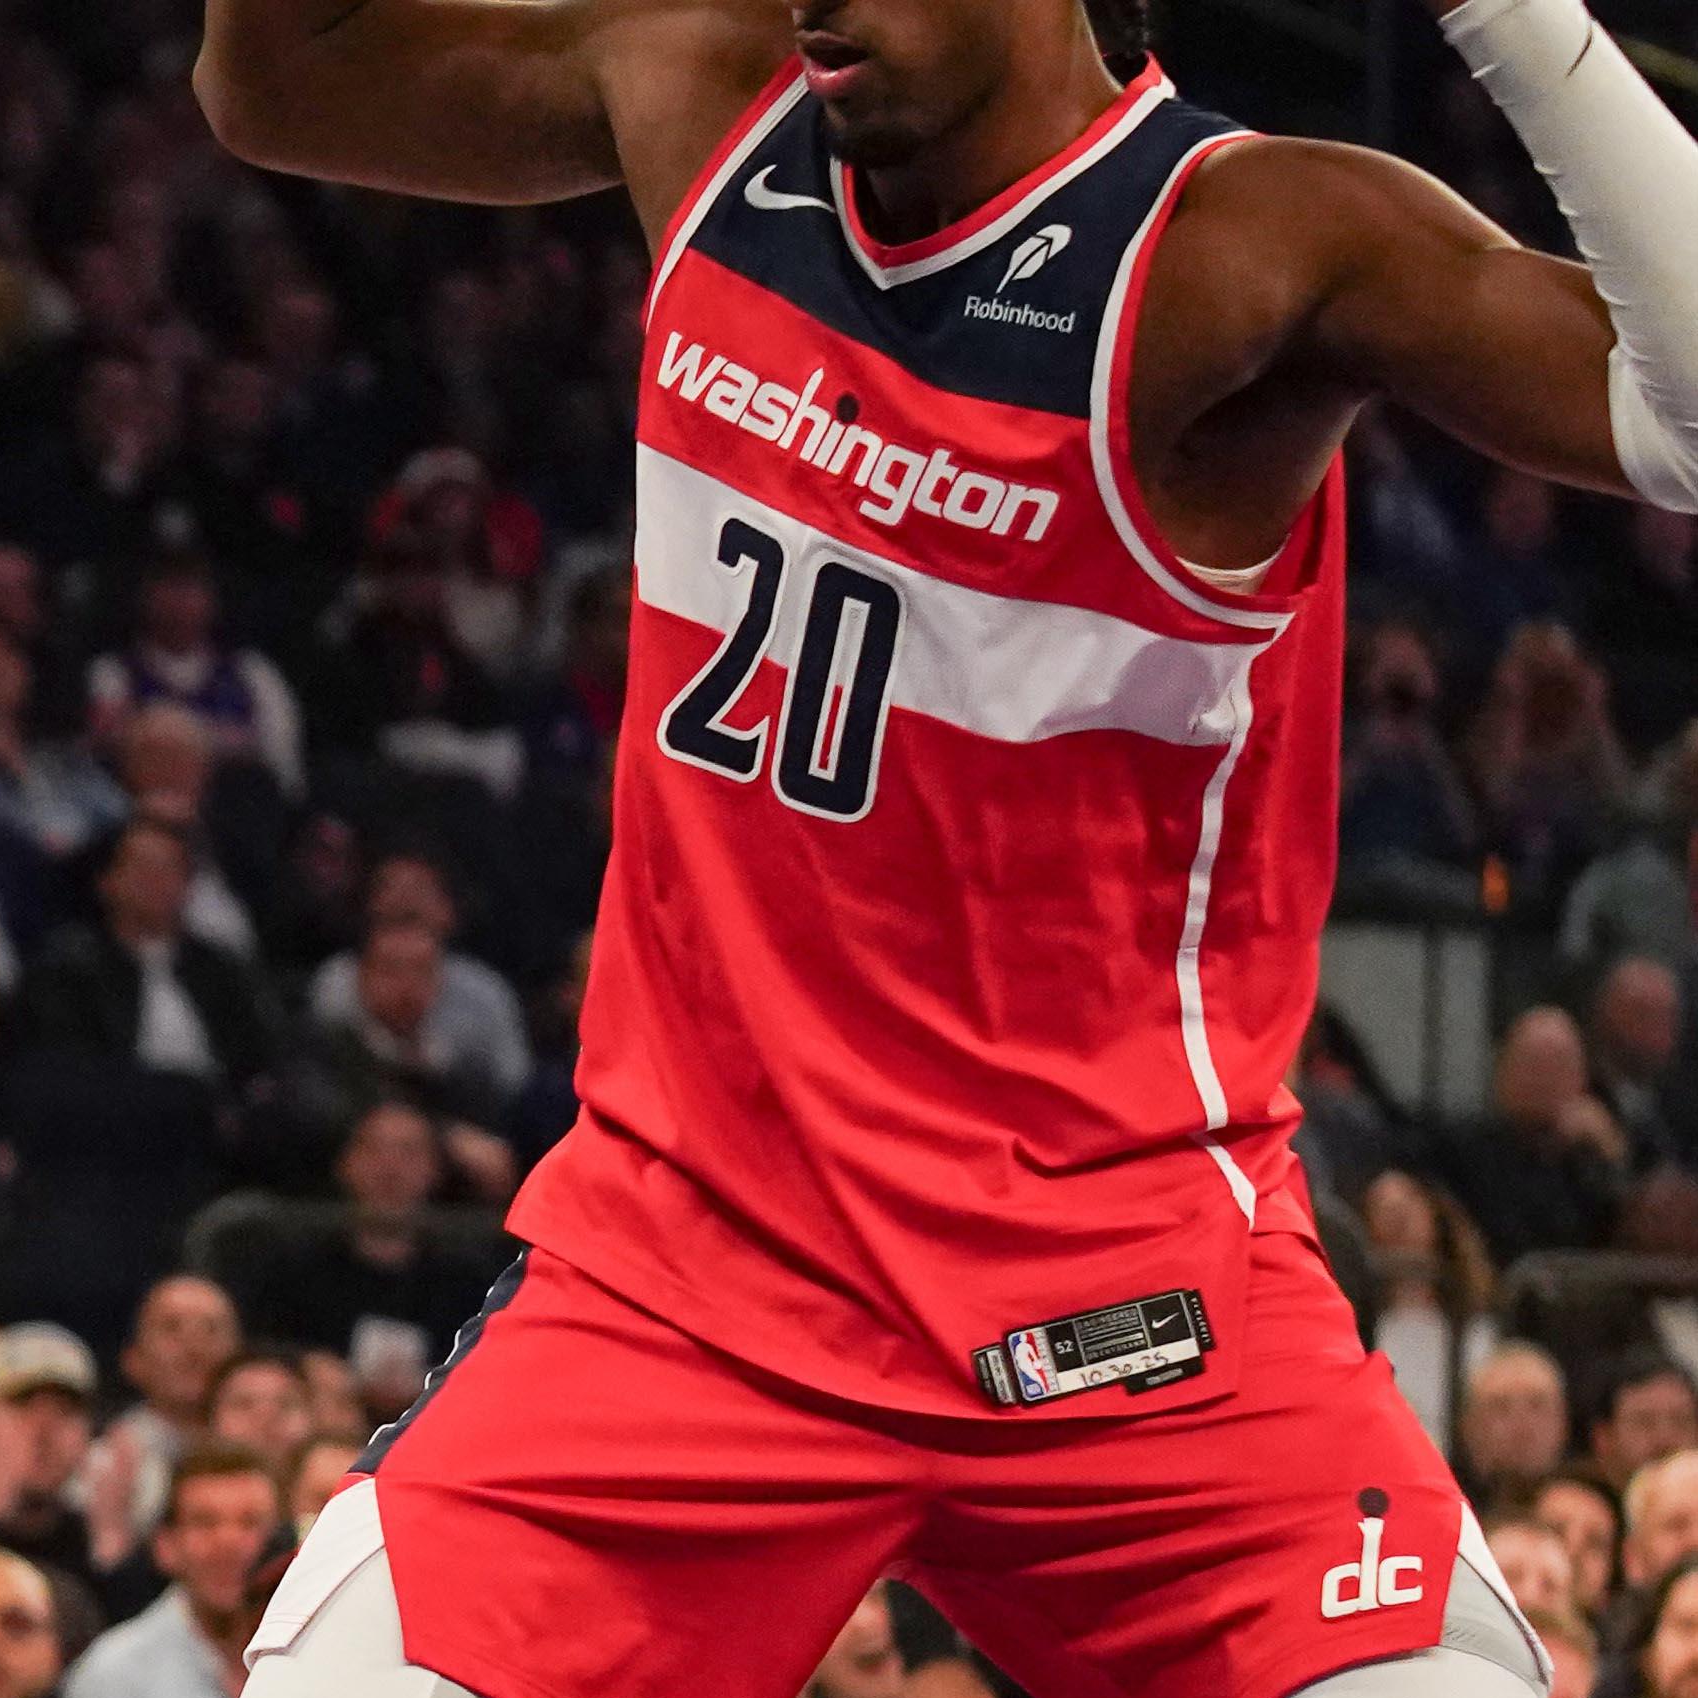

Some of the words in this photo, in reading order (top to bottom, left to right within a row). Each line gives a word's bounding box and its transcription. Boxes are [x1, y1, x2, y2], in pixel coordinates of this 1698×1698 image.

[963, 295, 1076, 334] Robinhood
[656, 330, 1059, 542] washington
[656, 513, 907, 823] 20
[1054, 1340, 1075, 1354] 52
[1320, 1517, 1424, 1621] dc
